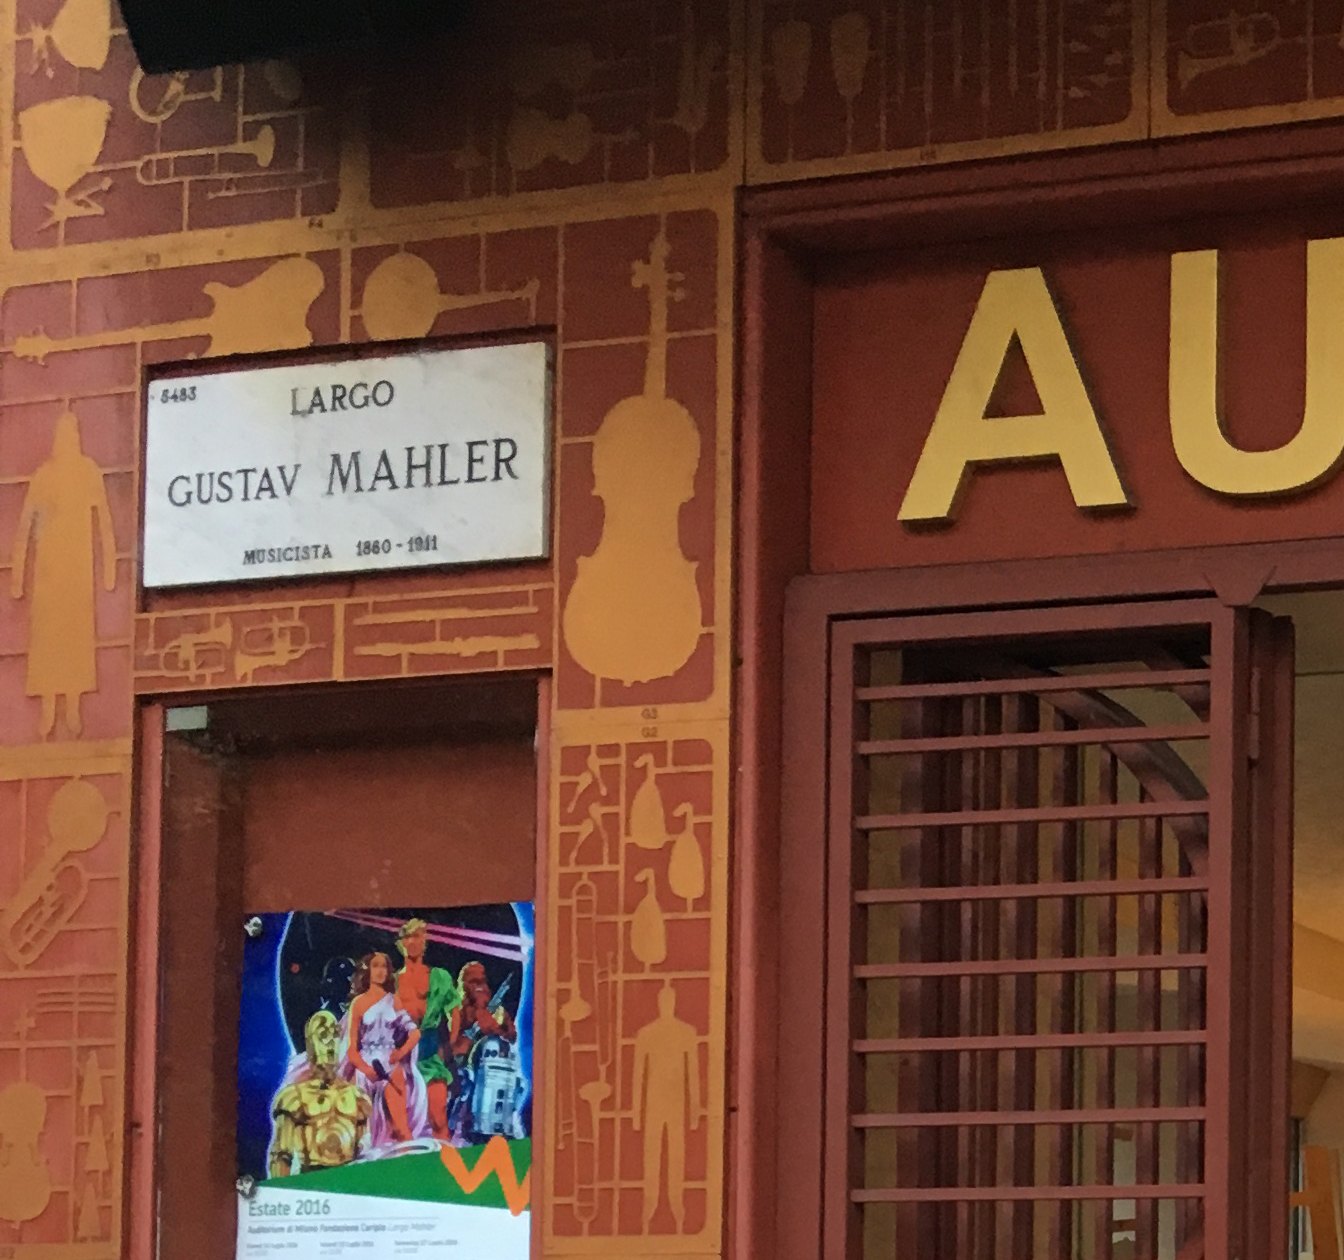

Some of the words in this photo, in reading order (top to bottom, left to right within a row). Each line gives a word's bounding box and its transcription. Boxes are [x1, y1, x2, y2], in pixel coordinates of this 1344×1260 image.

[160, 386, 197, 404] 5483
[289, 380, 395, 417] LARGO
[167, 463, 302, 508] GUSTAV
[325, 437, 520, 496] MAHLER
[242, 544, 334, 566] MUSICISTA
[355, 538, 392, 556] 1860
[407, 534, 438, 554] 1911
[248, 1200, 291, 1217] Estate
[295, 1198, 331, 1217] 2016
